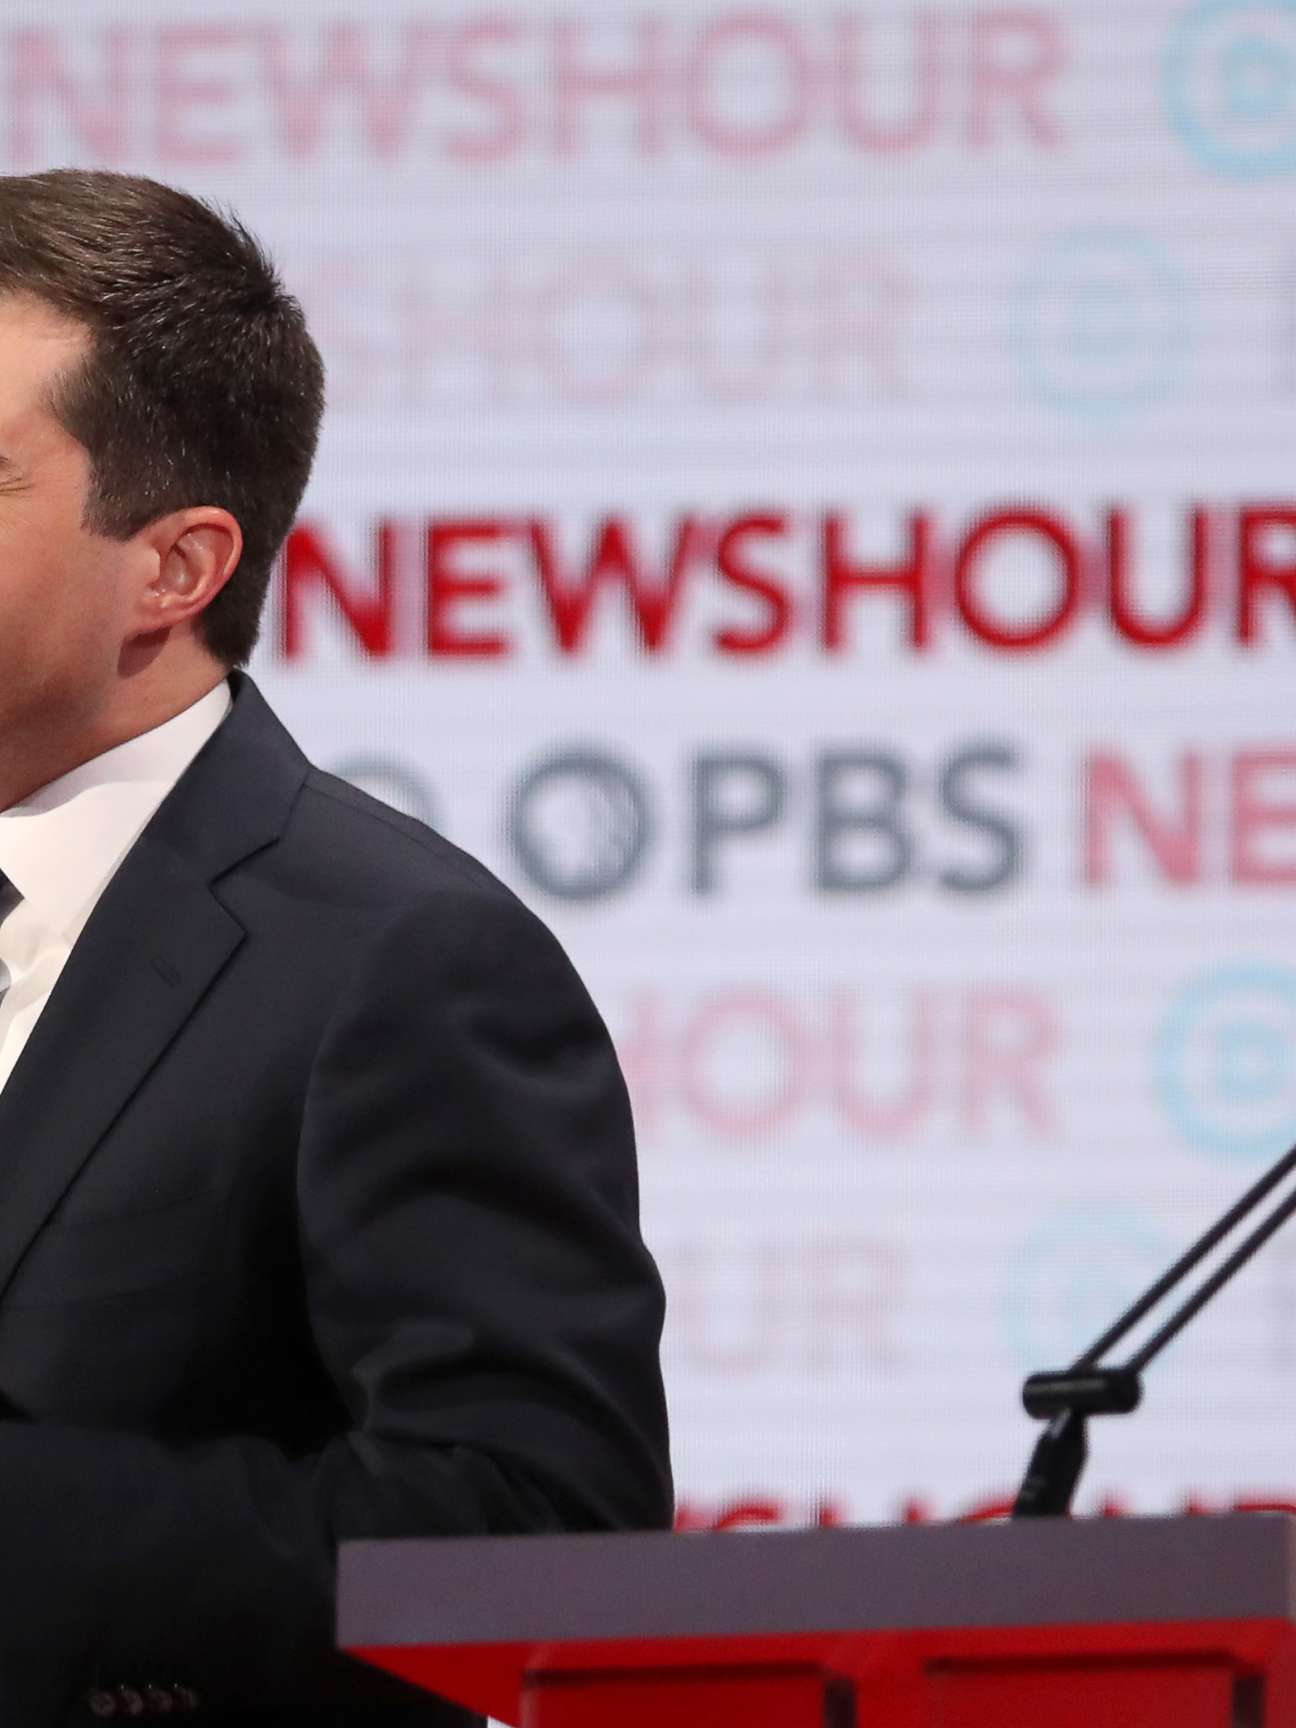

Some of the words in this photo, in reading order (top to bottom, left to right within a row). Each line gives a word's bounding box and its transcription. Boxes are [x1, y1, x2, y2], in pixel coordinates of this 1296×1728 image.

[4, 10, 1066, 166] NEWSHOUR
[280, 502, 1296, 664] NEWSHOUR
[686, 738, 1026, 902] PBS
